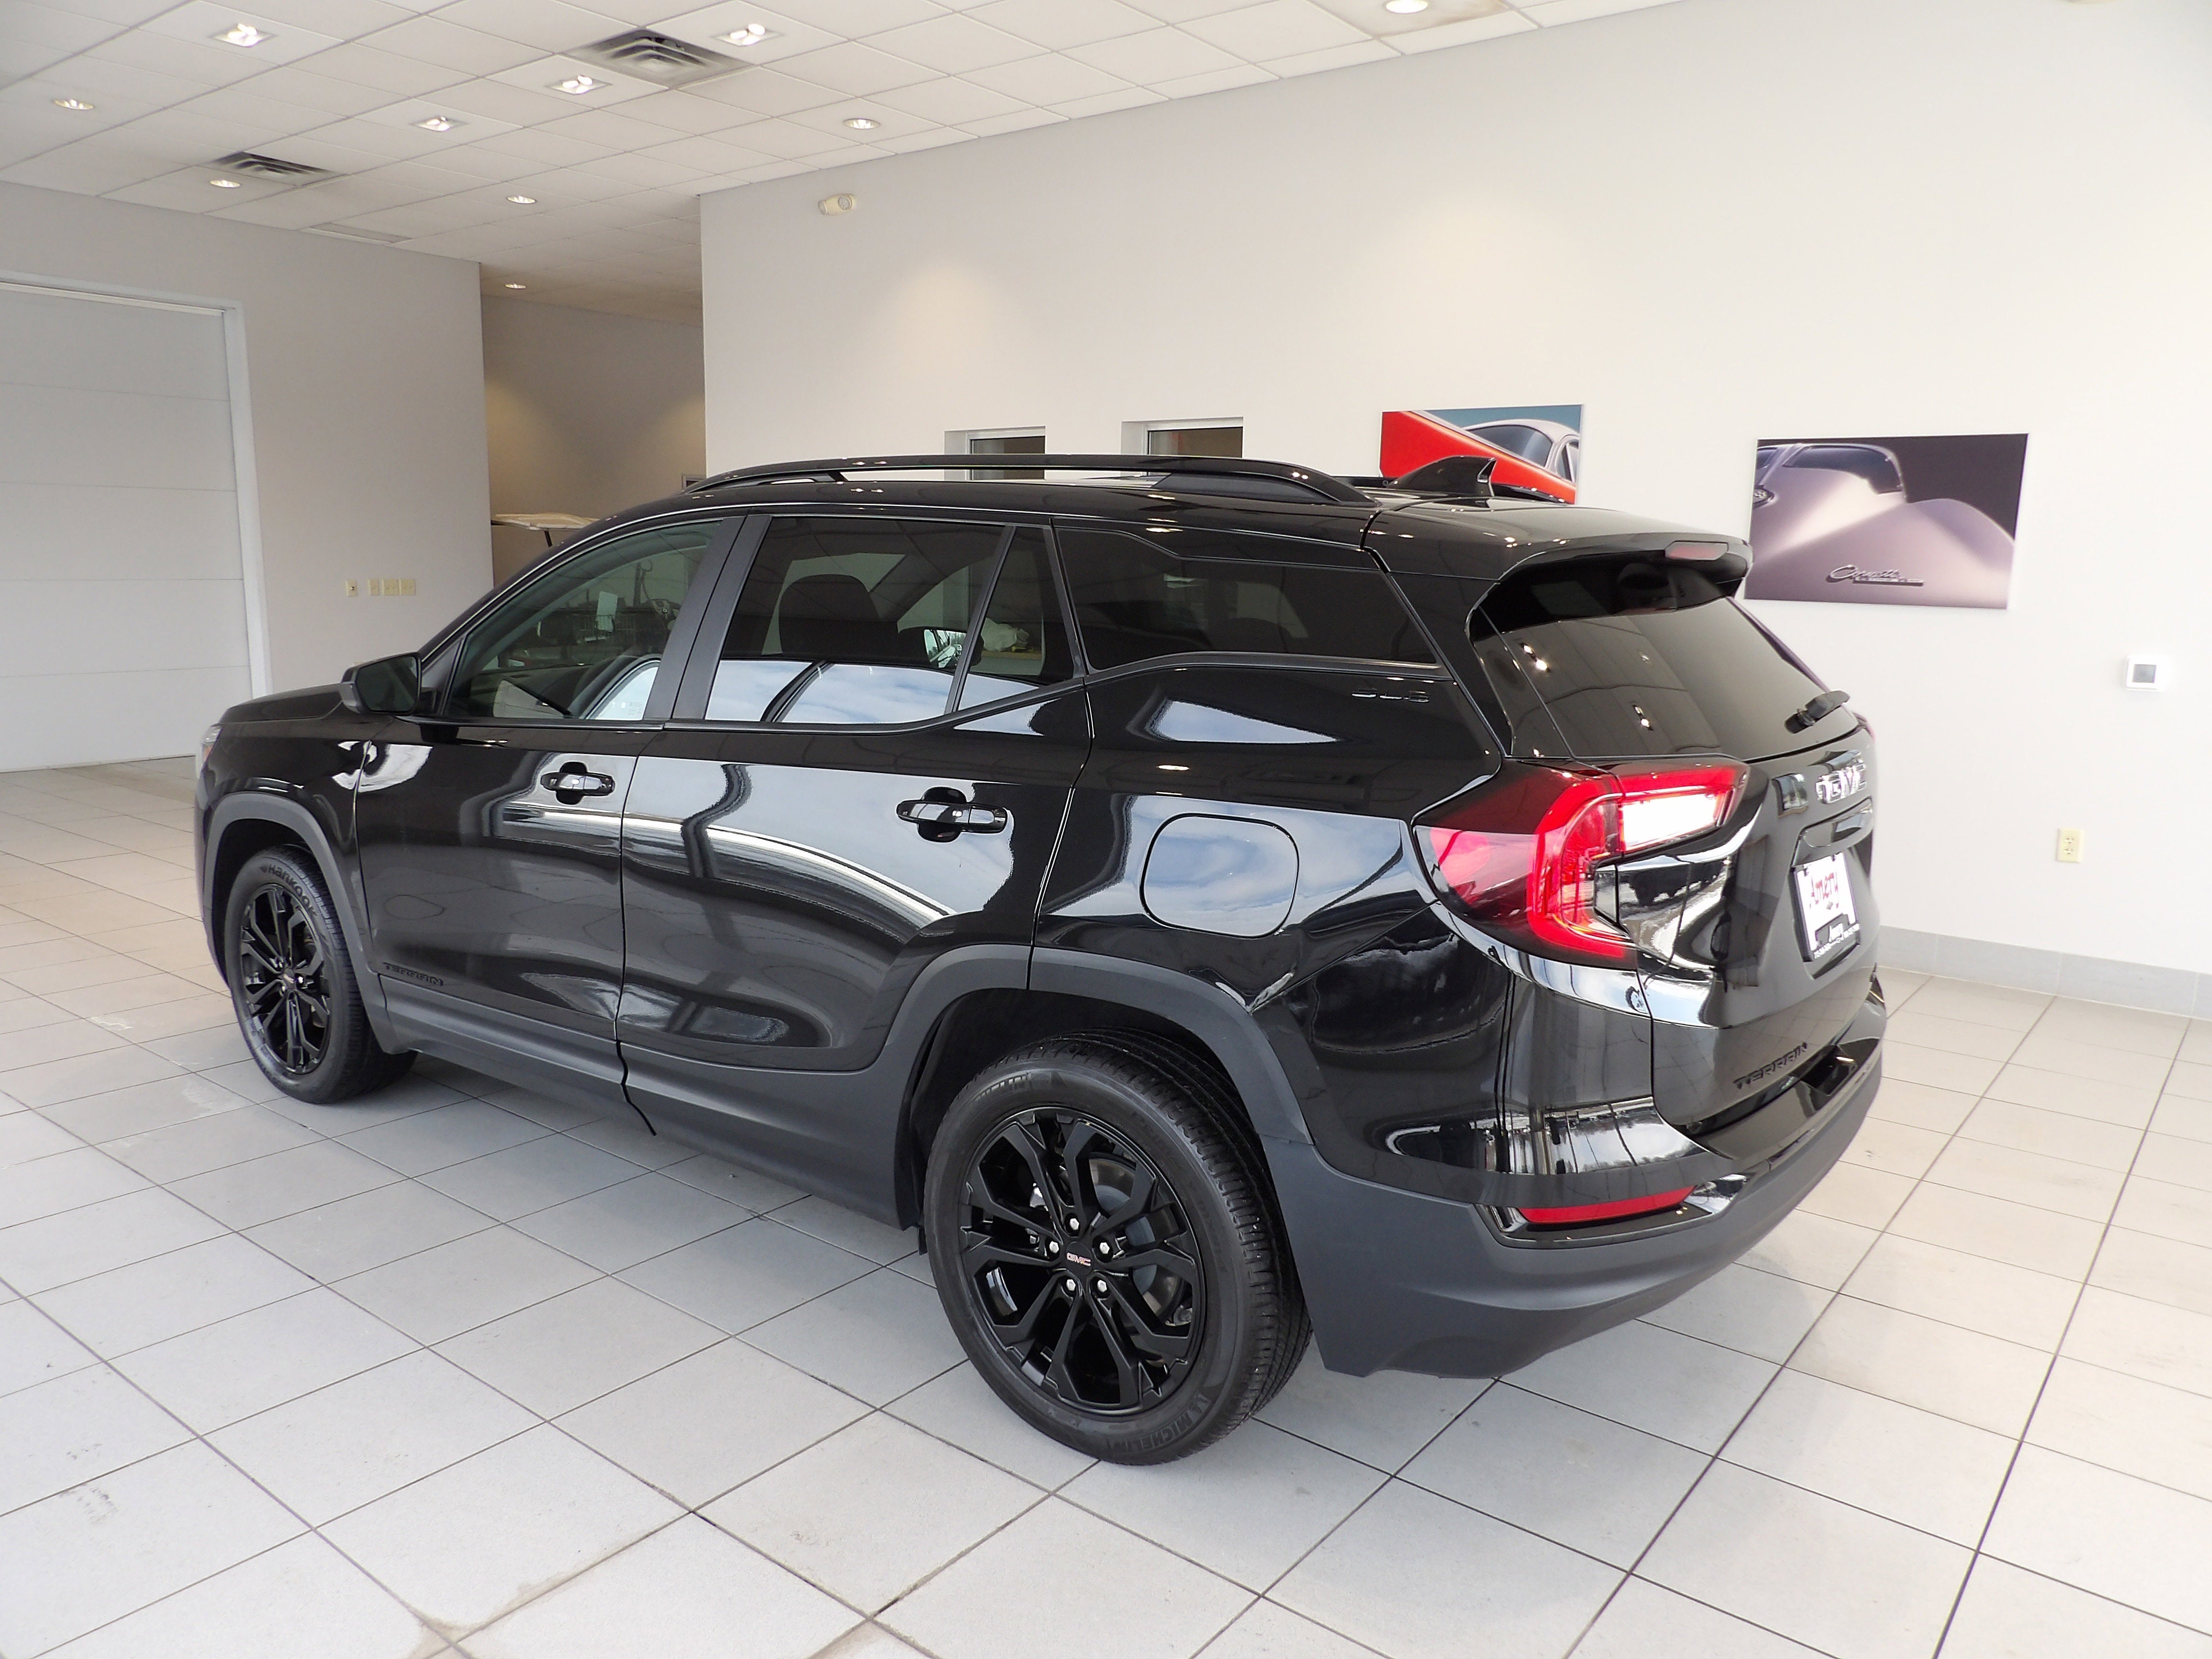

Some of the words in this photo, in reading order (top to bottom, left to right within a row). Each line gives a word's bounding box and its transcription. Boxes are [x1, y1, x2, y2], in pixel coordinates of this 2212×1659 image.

[383, 962, 444, 986] TERRAIN
[1732, 1041, 1808, 1090] TERRAIN
[1066, 1251, 1091, 1267] GMC
